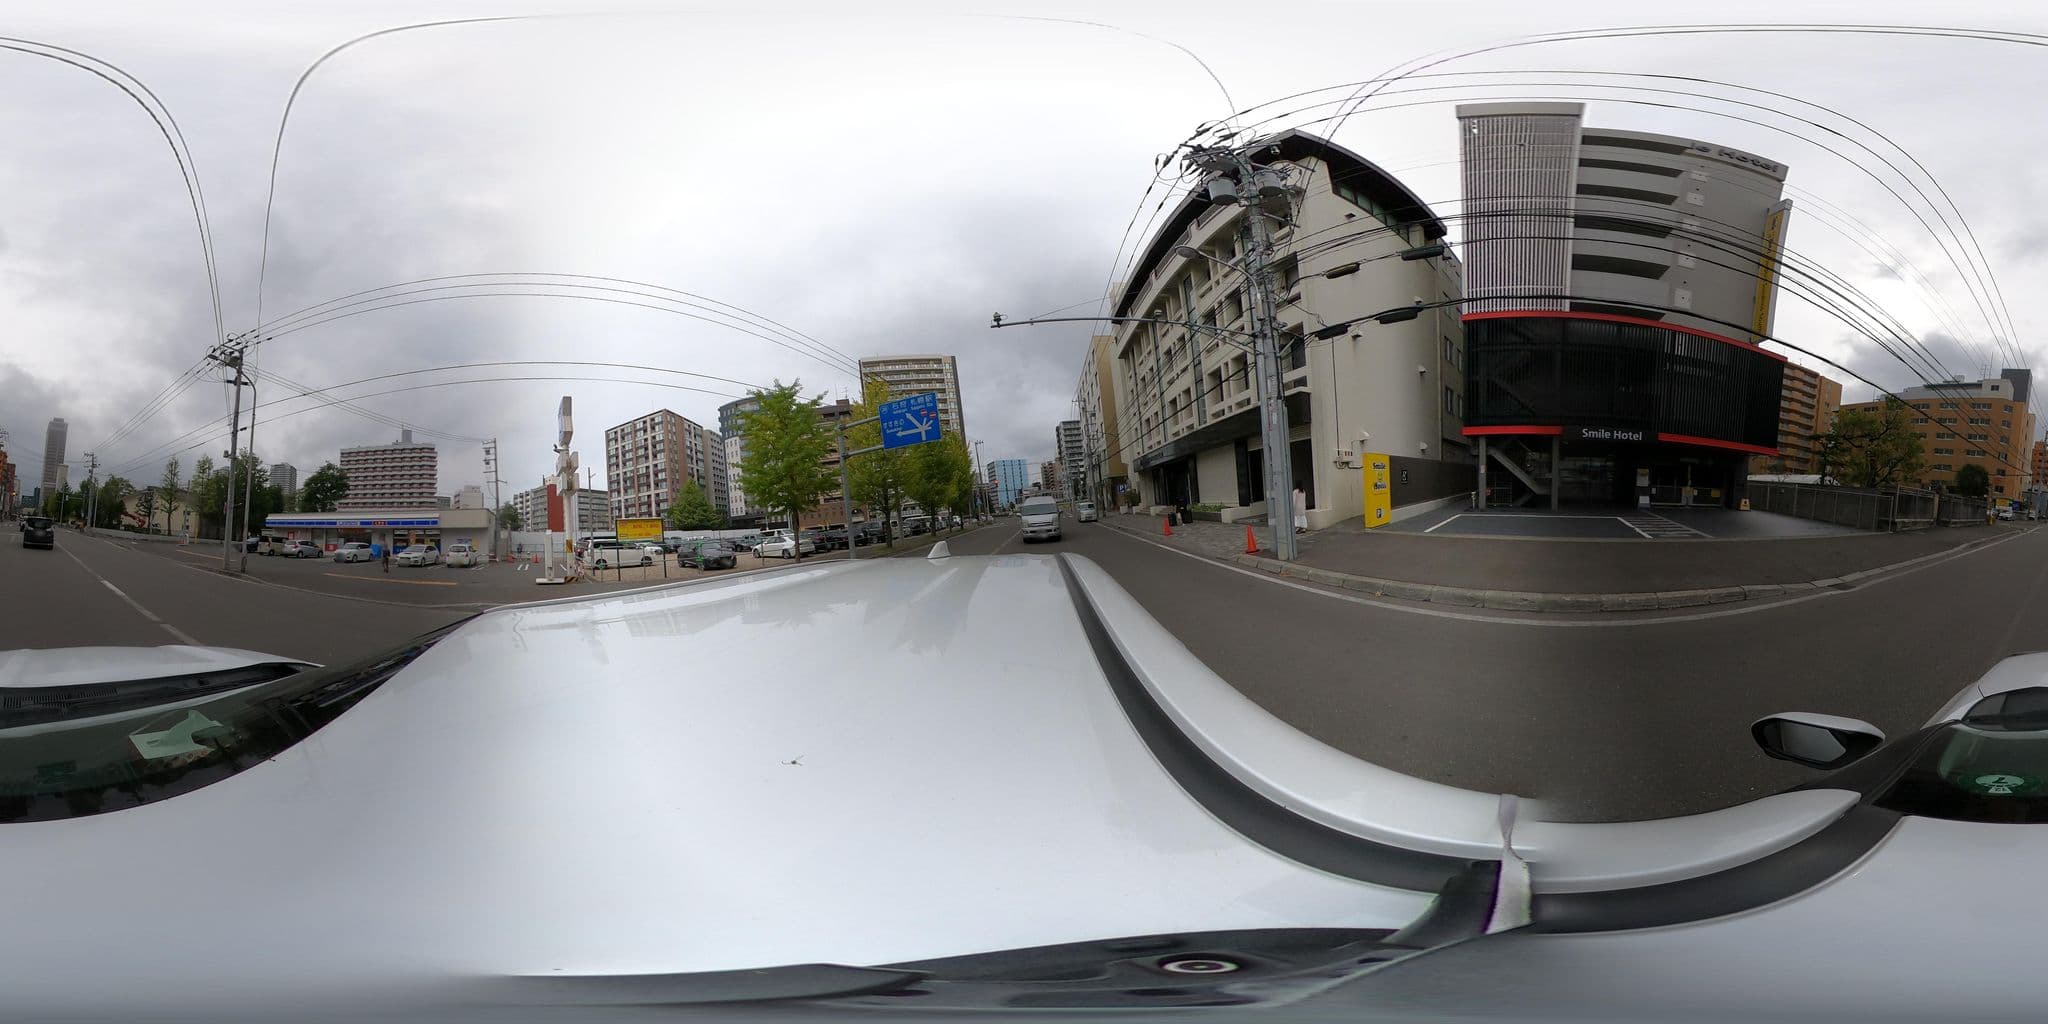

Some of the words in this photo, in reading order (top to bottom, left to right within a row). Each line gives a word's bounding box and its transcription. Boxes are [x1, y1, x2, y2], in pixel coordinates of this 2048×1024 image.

[1718, 148, 1779, 173] Hotel
[1582, 428, 1611, 439] Smile
[1613, 430, 1643, 441] Hotel
